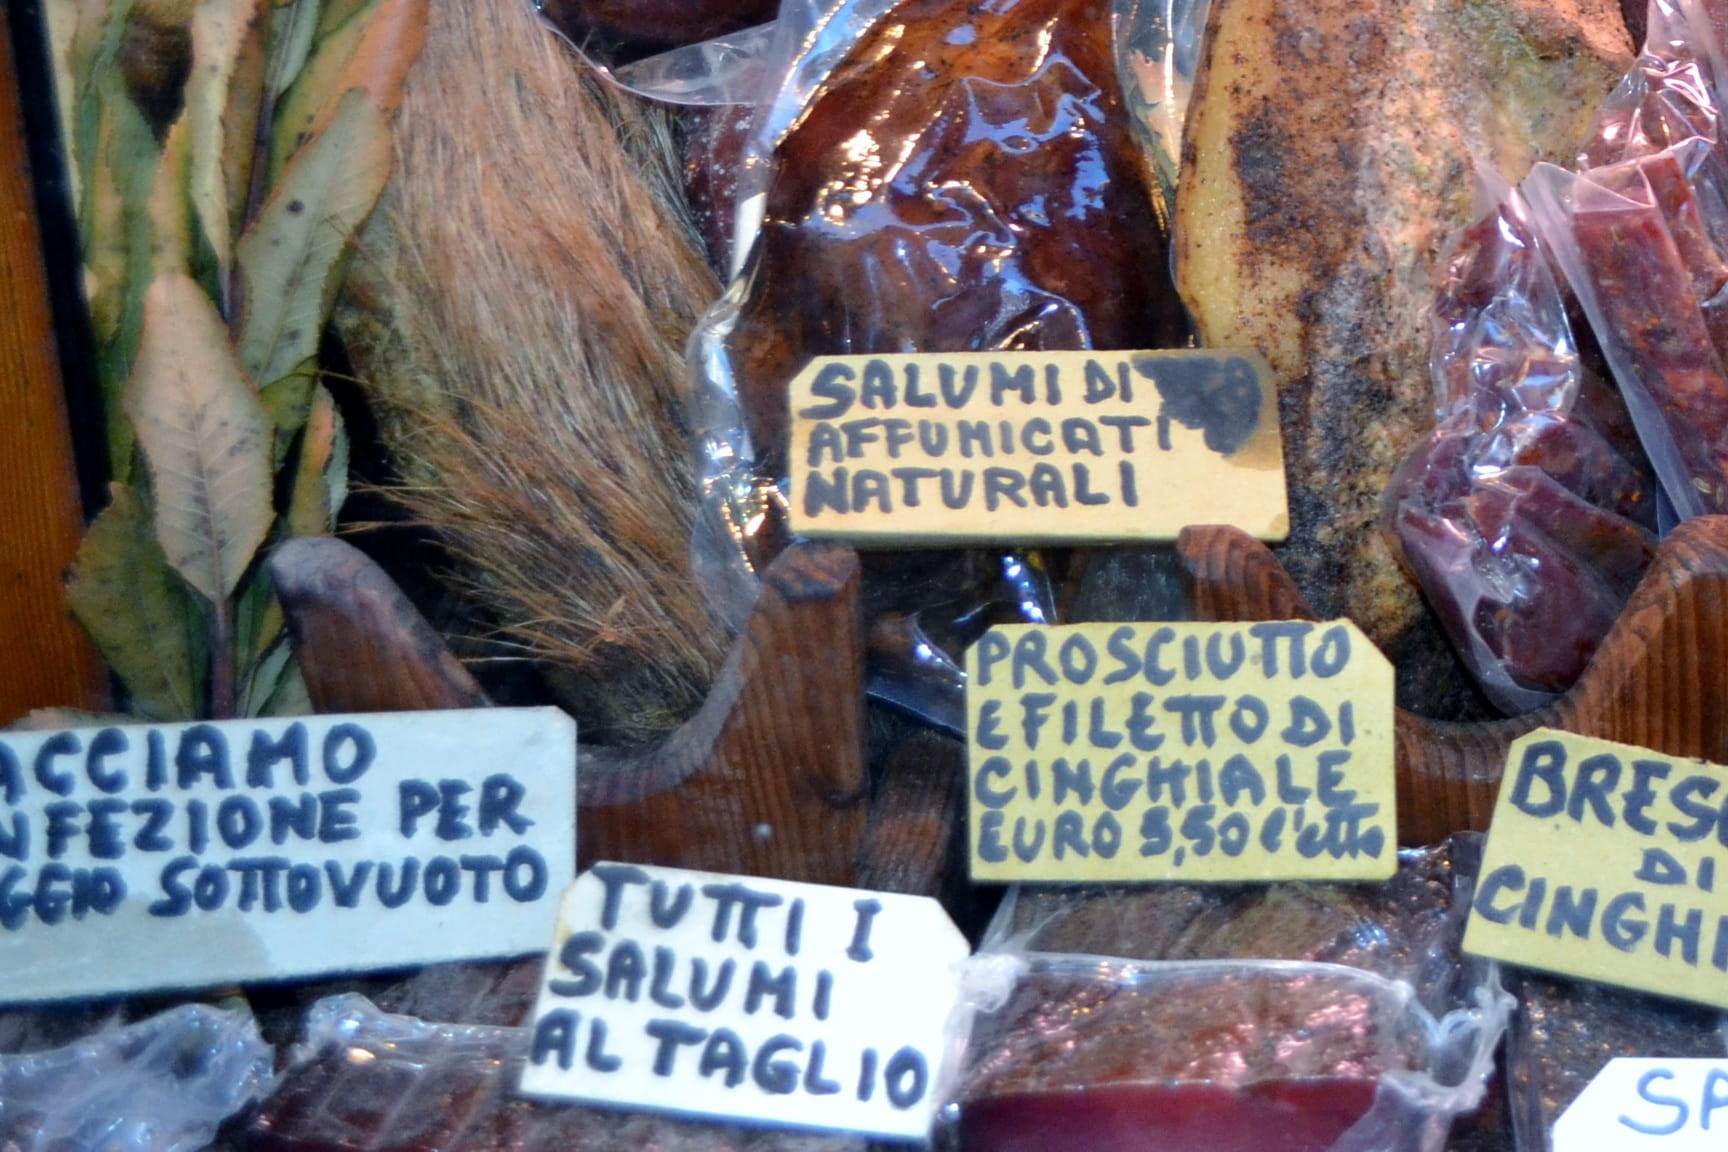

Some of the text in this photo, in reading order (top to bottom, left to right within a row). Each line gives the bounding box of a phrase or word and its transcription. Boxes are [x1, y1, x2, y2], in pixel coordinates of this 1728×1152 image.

[799, 360, 1134, 419] SALUMI DI
[808, 414, 1172, 466] AFFUMICATI
[804, 461, 1138, 517] NATURALI
[976, 622, 1351, 686] PROSCIUTTO
[976, 691, 1356, 751] E FILETTO DI
[400, 773, 535, 840] PER
[975, 749, 1357, 812] CINGHIALE
[980, 809, 1121, 863] EURO
[148, 847, 547, 918] SOTTOVUOTO
[1634, 848, 1713, 892] DI
[593, 864, 883, 962] TUTTI I
[549, 930, 832, 1020] SALUMI
[531, 1009, 930, 1110] AL TAGLIO
